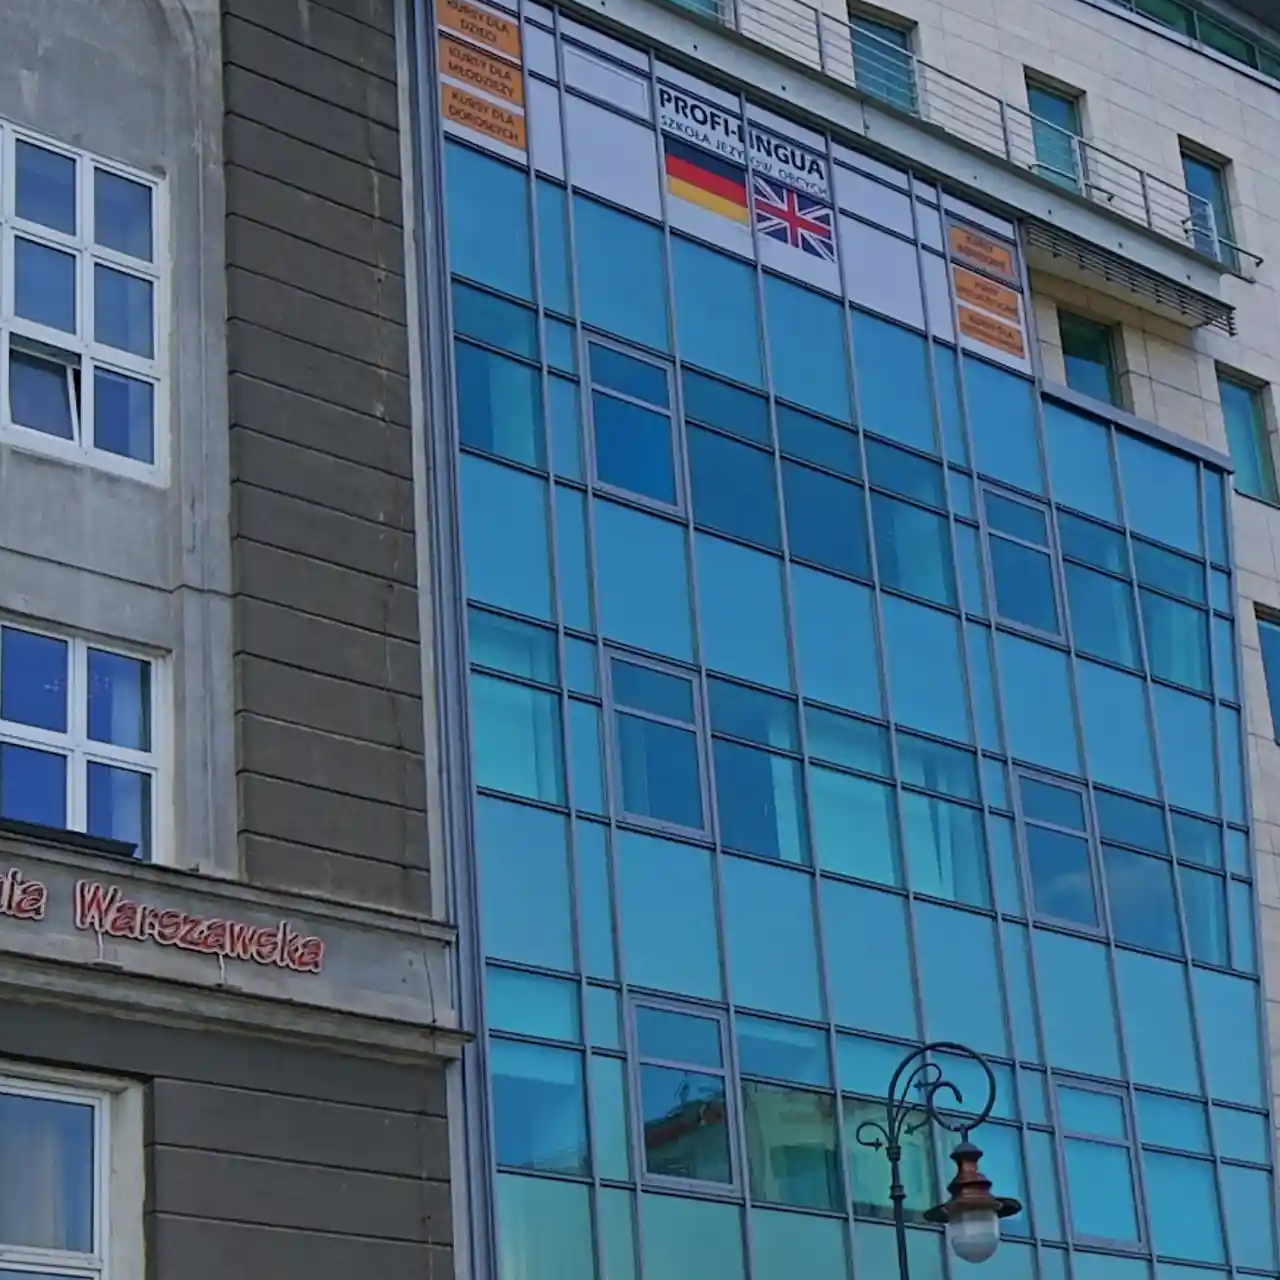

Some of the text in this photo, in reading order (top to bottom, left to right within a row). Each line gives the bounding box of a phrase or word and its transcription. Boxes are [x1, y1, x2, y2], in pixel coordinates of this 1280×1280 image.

[487, 18, 509, 34] DLA
[490, 64, 511, 80] DLA
[491, 108, 515, 126] DLA
[660, 114, 711, 145] SZKOŁA
[73, 877, 326, 975] Warszawska
